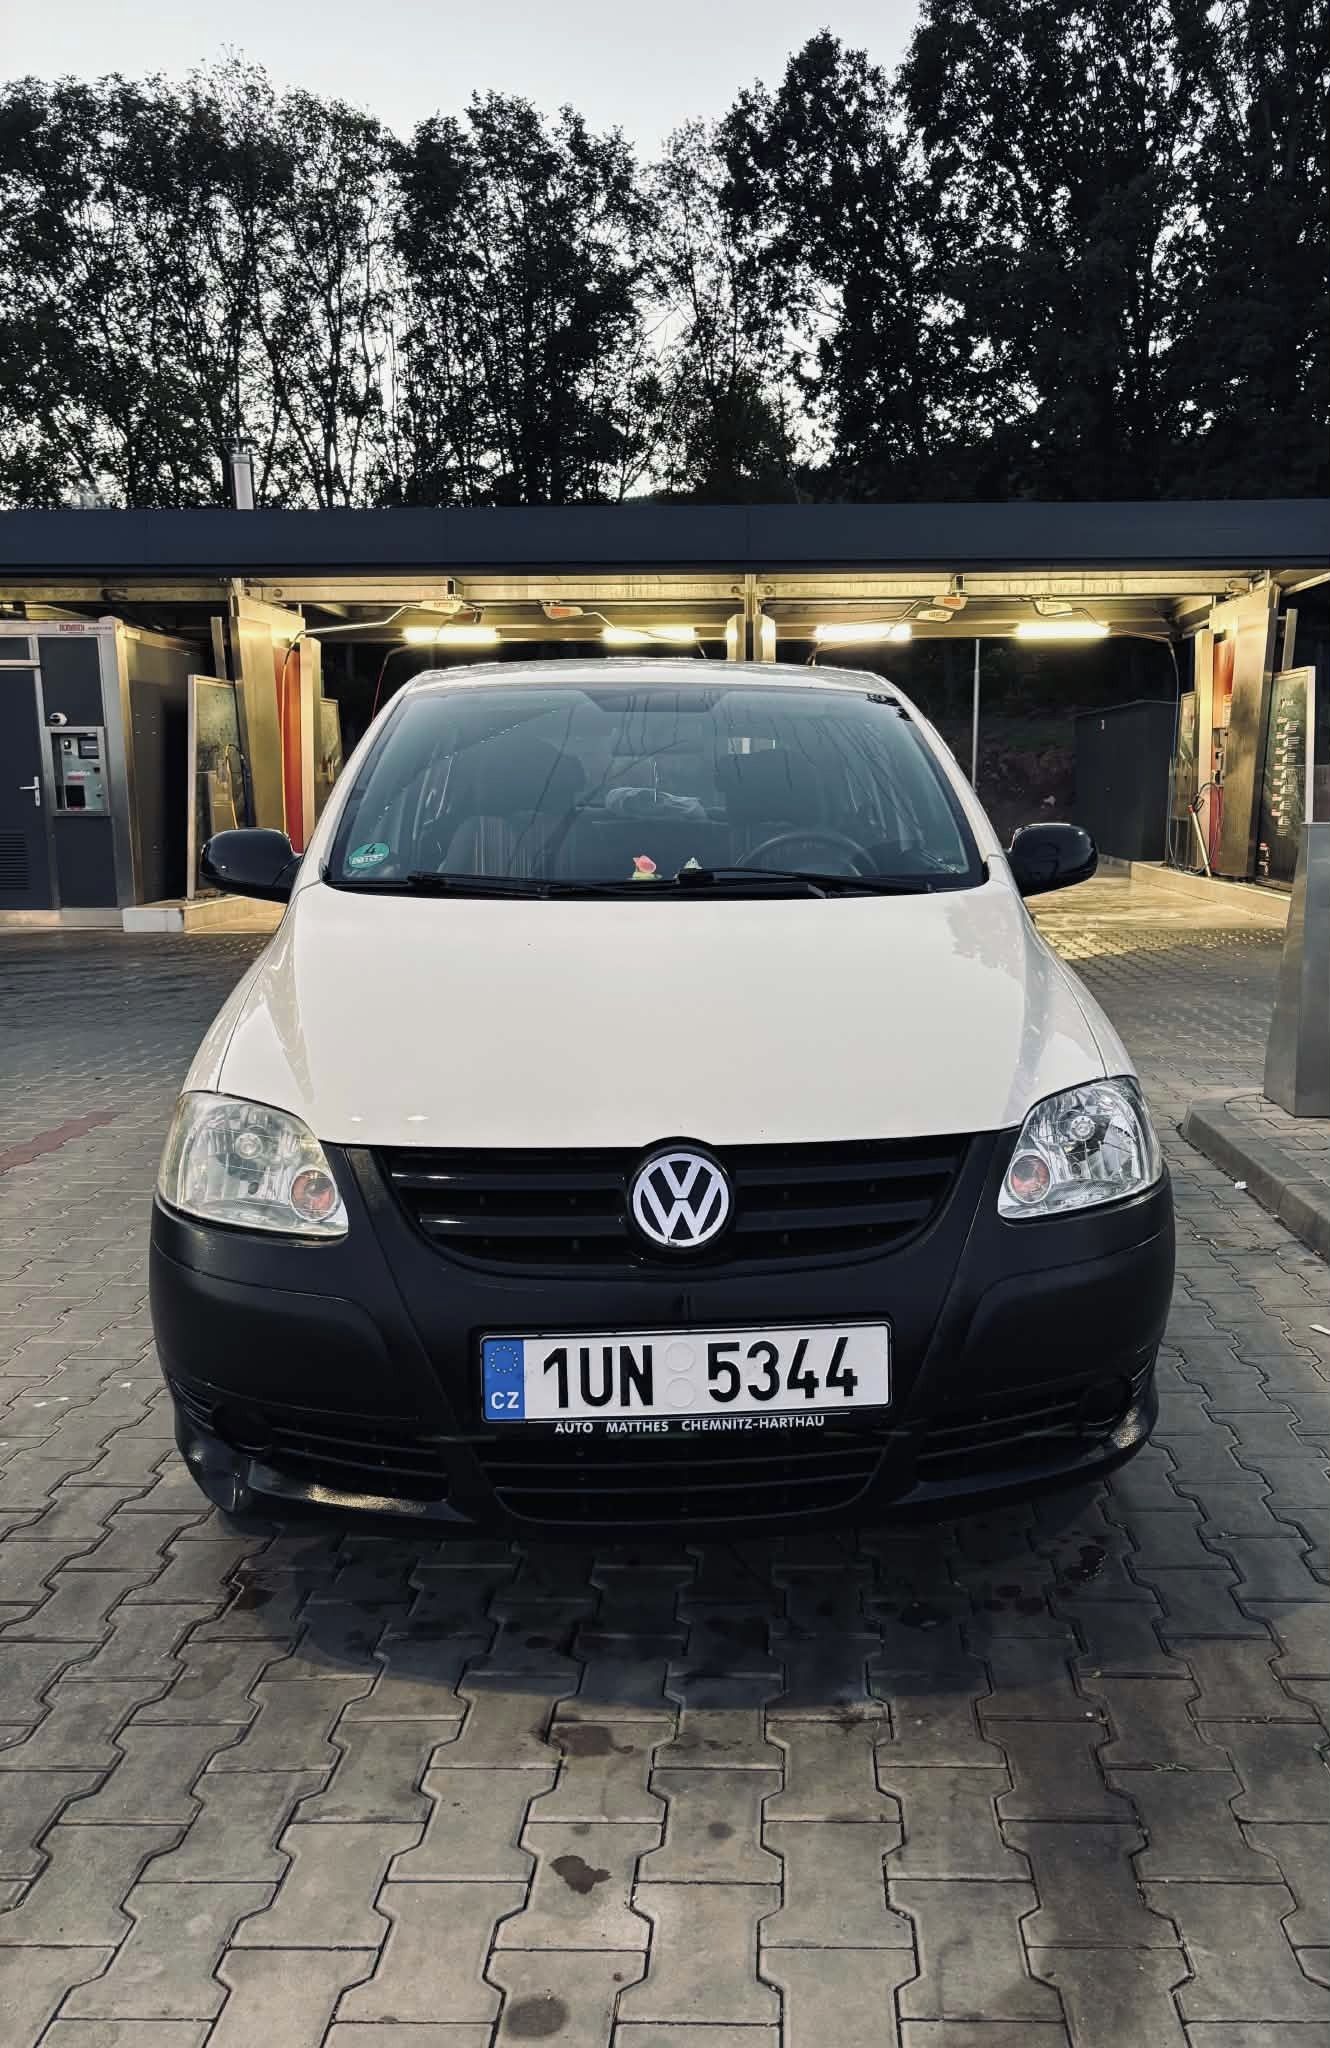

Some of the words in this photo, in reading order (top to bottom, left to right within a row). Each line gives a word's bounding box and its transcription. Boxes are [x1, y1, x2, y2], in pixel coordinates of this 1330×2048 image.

[633, 1153, 729, 1247] VW
[543, 1344, 654, 1409] 1UN
[706, 1336, 859, 1404] 5344
[490, 1391, 520, 1410] CZ
[554, 1422, 594, 1434] AUTO
[605, 1420, 670, 1433] MATTHES
[681, 1415, 825, 1432] CHEMNITZ-HARTHAU
